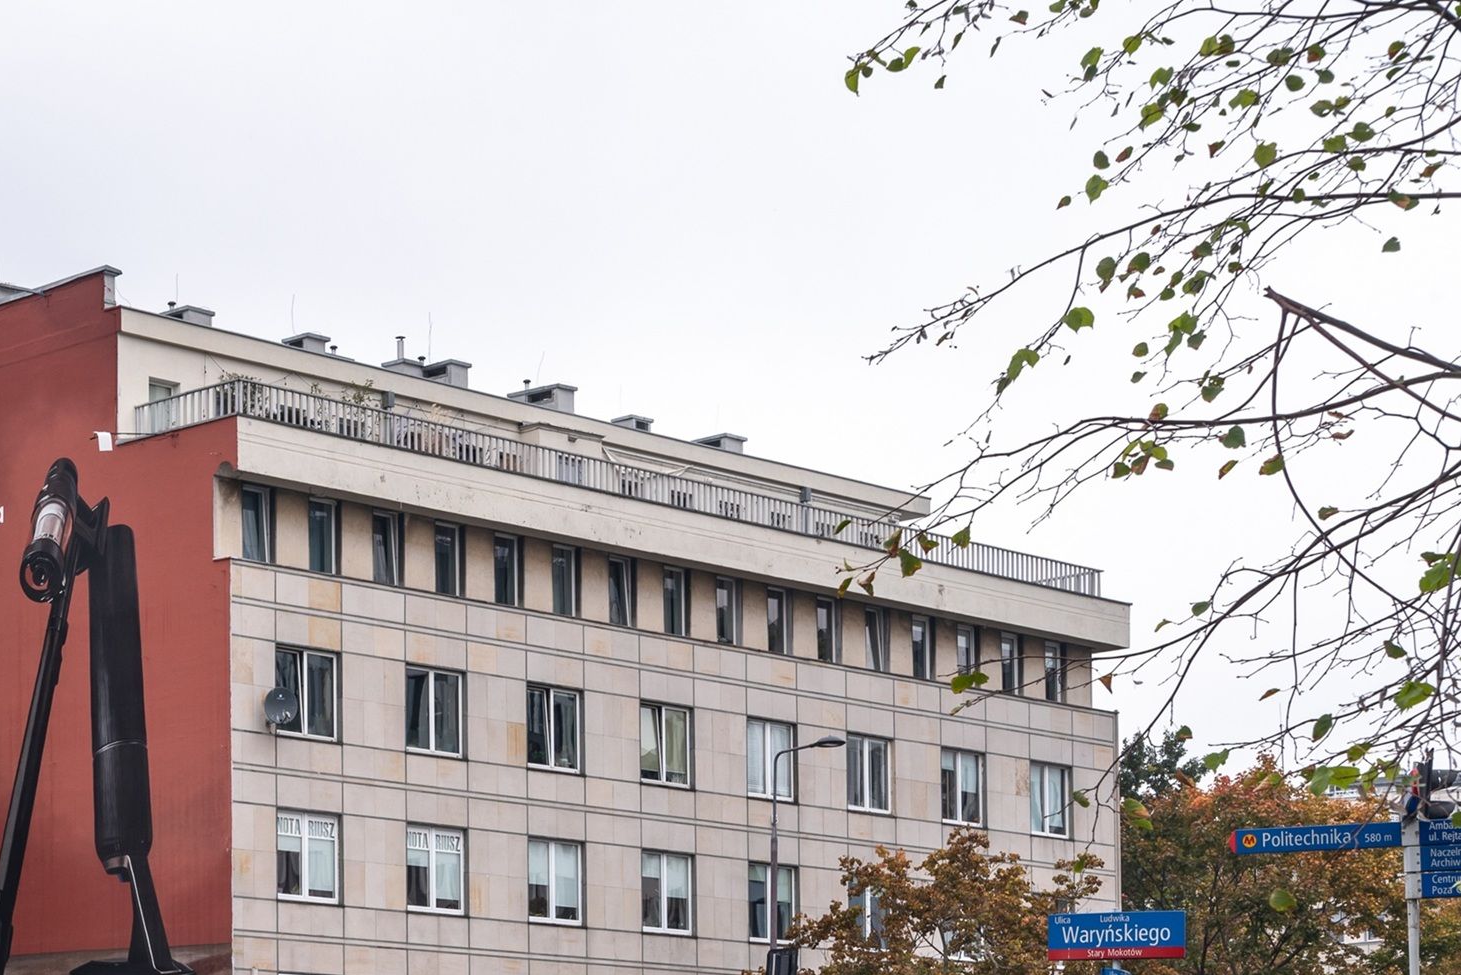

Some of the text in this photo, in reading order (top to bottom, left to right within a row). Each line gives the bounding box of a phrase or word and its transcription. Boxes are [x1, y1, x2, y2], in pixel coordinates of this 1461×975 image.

[1262, 829, 1352, 849] Politechnika
[1364, 833, 1382, 842] 580
[1429, 832, 1440, 841] ul.
[1054, 914, 1130, 924] Ulica Ludwika
[1062, 922, 1171, 946] Waryńskiego
[1087, 947, 1142, 958] Stary Mokotów
